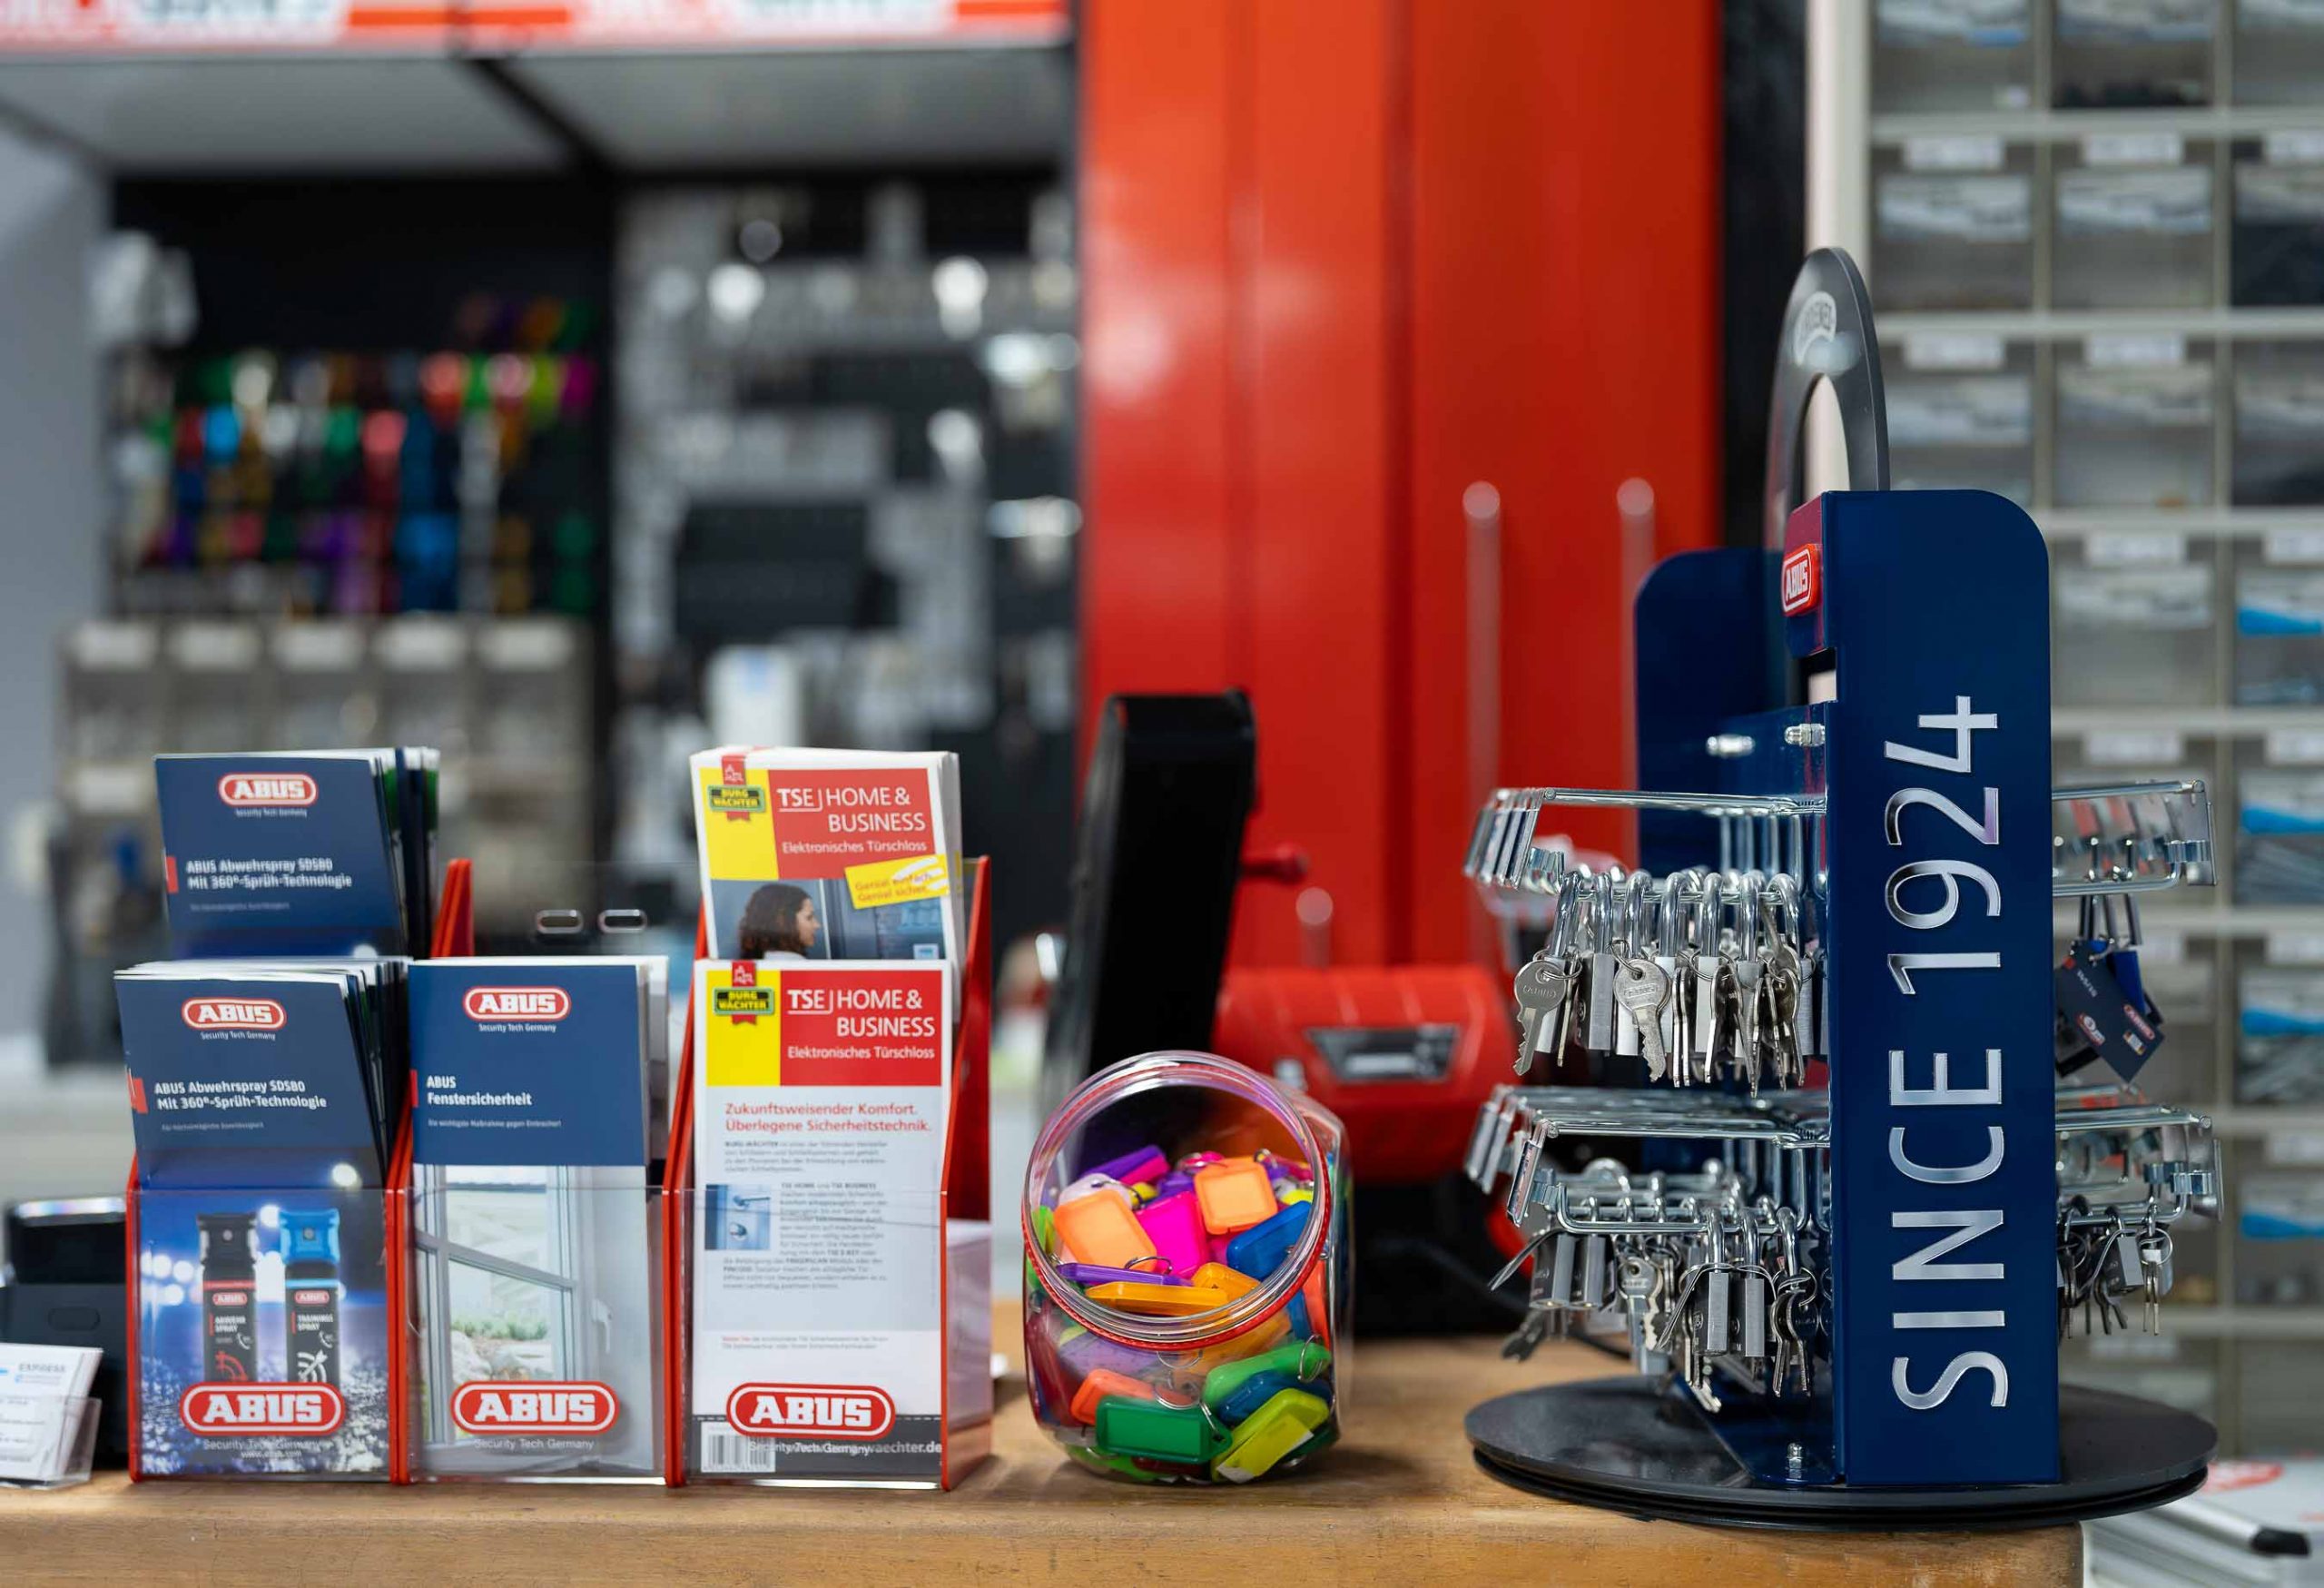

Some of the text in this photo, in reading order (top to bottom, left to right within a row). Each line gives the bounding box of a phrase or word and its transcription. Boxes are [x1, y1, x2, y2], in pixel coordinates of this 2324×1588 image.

[1786, 559, 1808, 602] ABUS
[234, 780, 307, 799] ABUS
[777, 787, 911, 806] TSE HOME &
[235, 808, 308, 818] Security Tech Germany
[828, 813, 926, 833] BUSINESS
[783, 840, 927, 853] Elektronisches Türschloss
[186, 860, 216, 873] ABUS
[220, 859, 296, 874] Abwehrspray
[188, 876, 210, 890] Mit
[728, 991, 756, 999] BURG
[788, 990, 922, 1010] TSE HOME &
[478, 994, 556, 1013] ABUS
[718, 1000, 766, 1010] WÄCHTER
[198, 1004, 272, 1023] ABUS
[478, 1023, 556, 1033] Security Tech Germany
[837, 1017, 935, 1037] BUSINESS
[201, 1031, 276, 1041] Security Tech Germany
[788, 1045, 935, 1059] Elektronisches Türschloss
[1884, 695, 2009, 1409] SINCE 1924
[154, 1079, 306, 1096] ABUS Abwehrspray SDS80
[427, 1076, 456, 1089] ABUS
[158, 1095, 327, 1110] Mit 360°-Sprüh-Technologie
[428, 1092, 532, 1105] Fenstersicherheit
[725, 1102, 917, 1116] Zukunftsweisender Komfort.
[725, 1117, 931, 1133] Überlegene Sicherheitstechnik.
[202, 1394, 322, 1423] ABUS
[474, 1393, 596, 1423] ABUS
[750, 1396, 872, 1427] ABUS
[203, 1438, 242, 1452] Security
[474, 1438, 595, 1450] Security Tech Germany
[749, 1441, 791, 1455] Security
